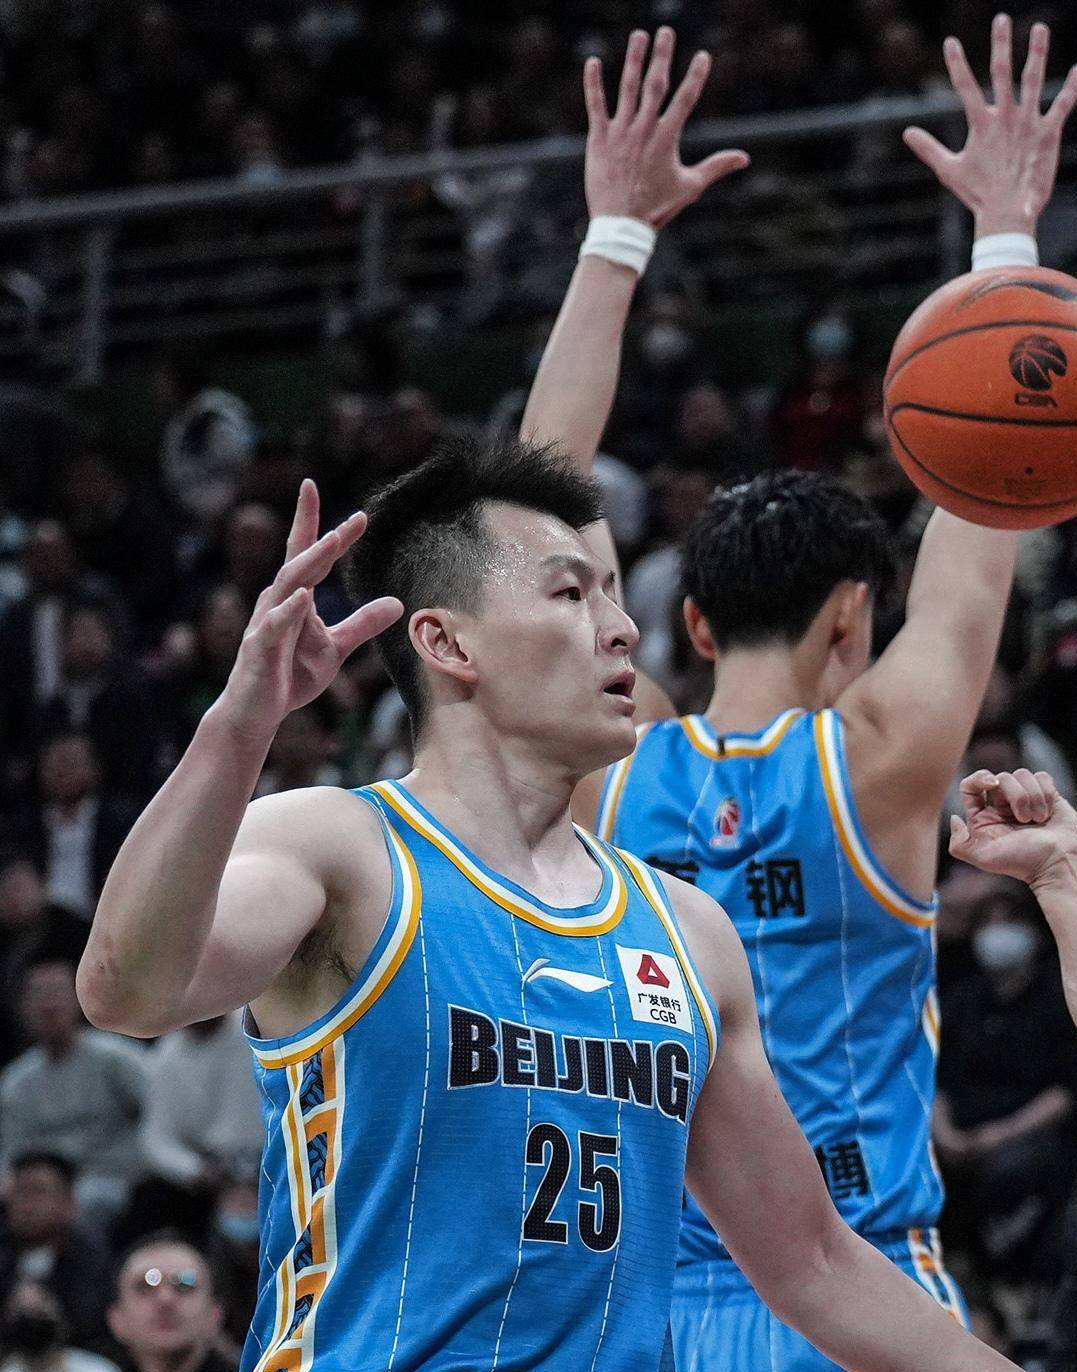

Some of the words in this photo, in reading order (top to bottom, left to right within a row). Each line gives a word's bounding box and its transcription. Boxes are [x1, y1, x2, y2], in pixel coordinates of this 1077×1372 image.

[637, 993, 682, 1013] 广发银行
[650, 1008, 677, 1025] CGB
[447, 1003, 692, 1125] BEIJING
[522, 1122, 622, 1253] 25
